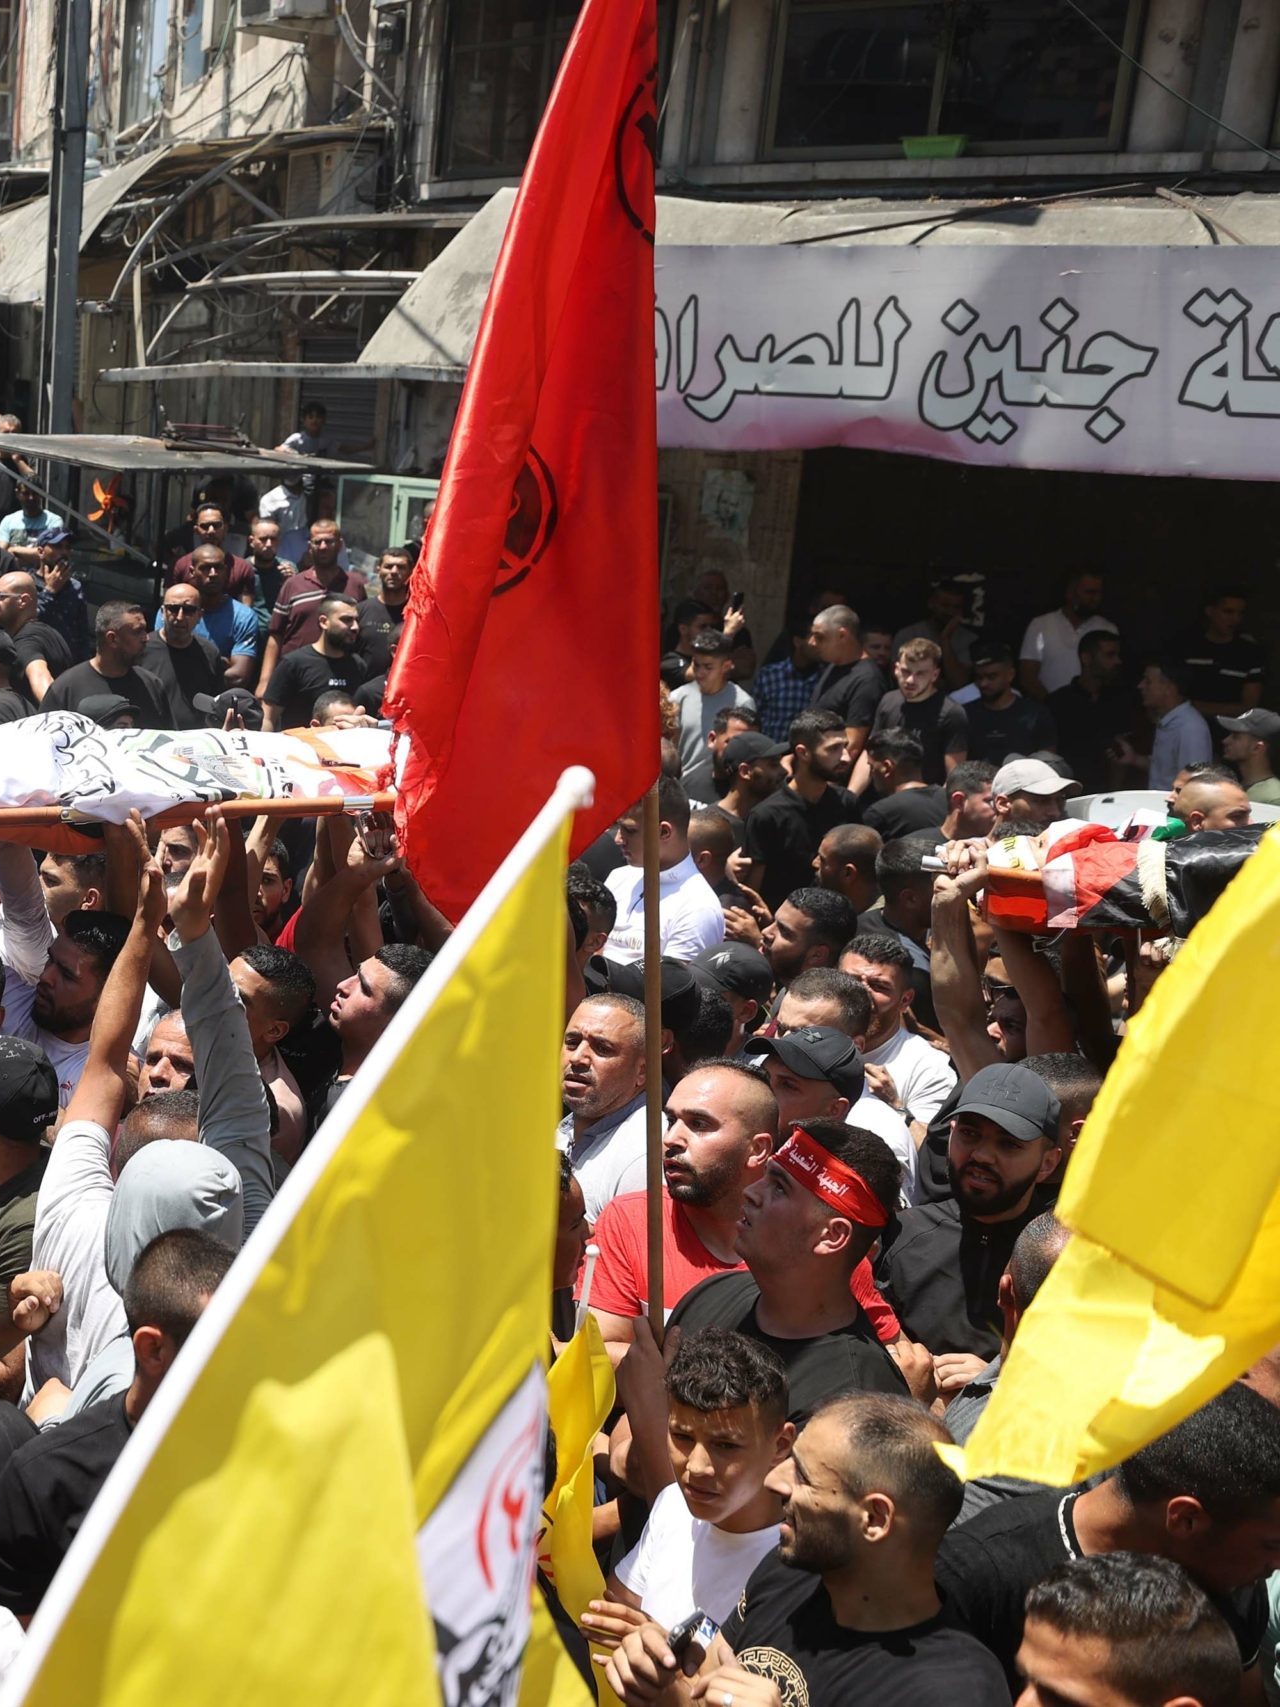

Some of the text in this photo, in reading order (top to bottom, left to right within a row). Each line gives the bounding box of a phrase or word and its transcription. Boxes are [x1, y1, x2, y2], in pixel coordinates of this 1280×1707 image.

[654, 295, 911, 423] للصرا
[918, 298, 1158, 443] جنين
[789, 1143, 819, 1174] الشعبية
[817, 1167, 850, 1197] الجبهة
